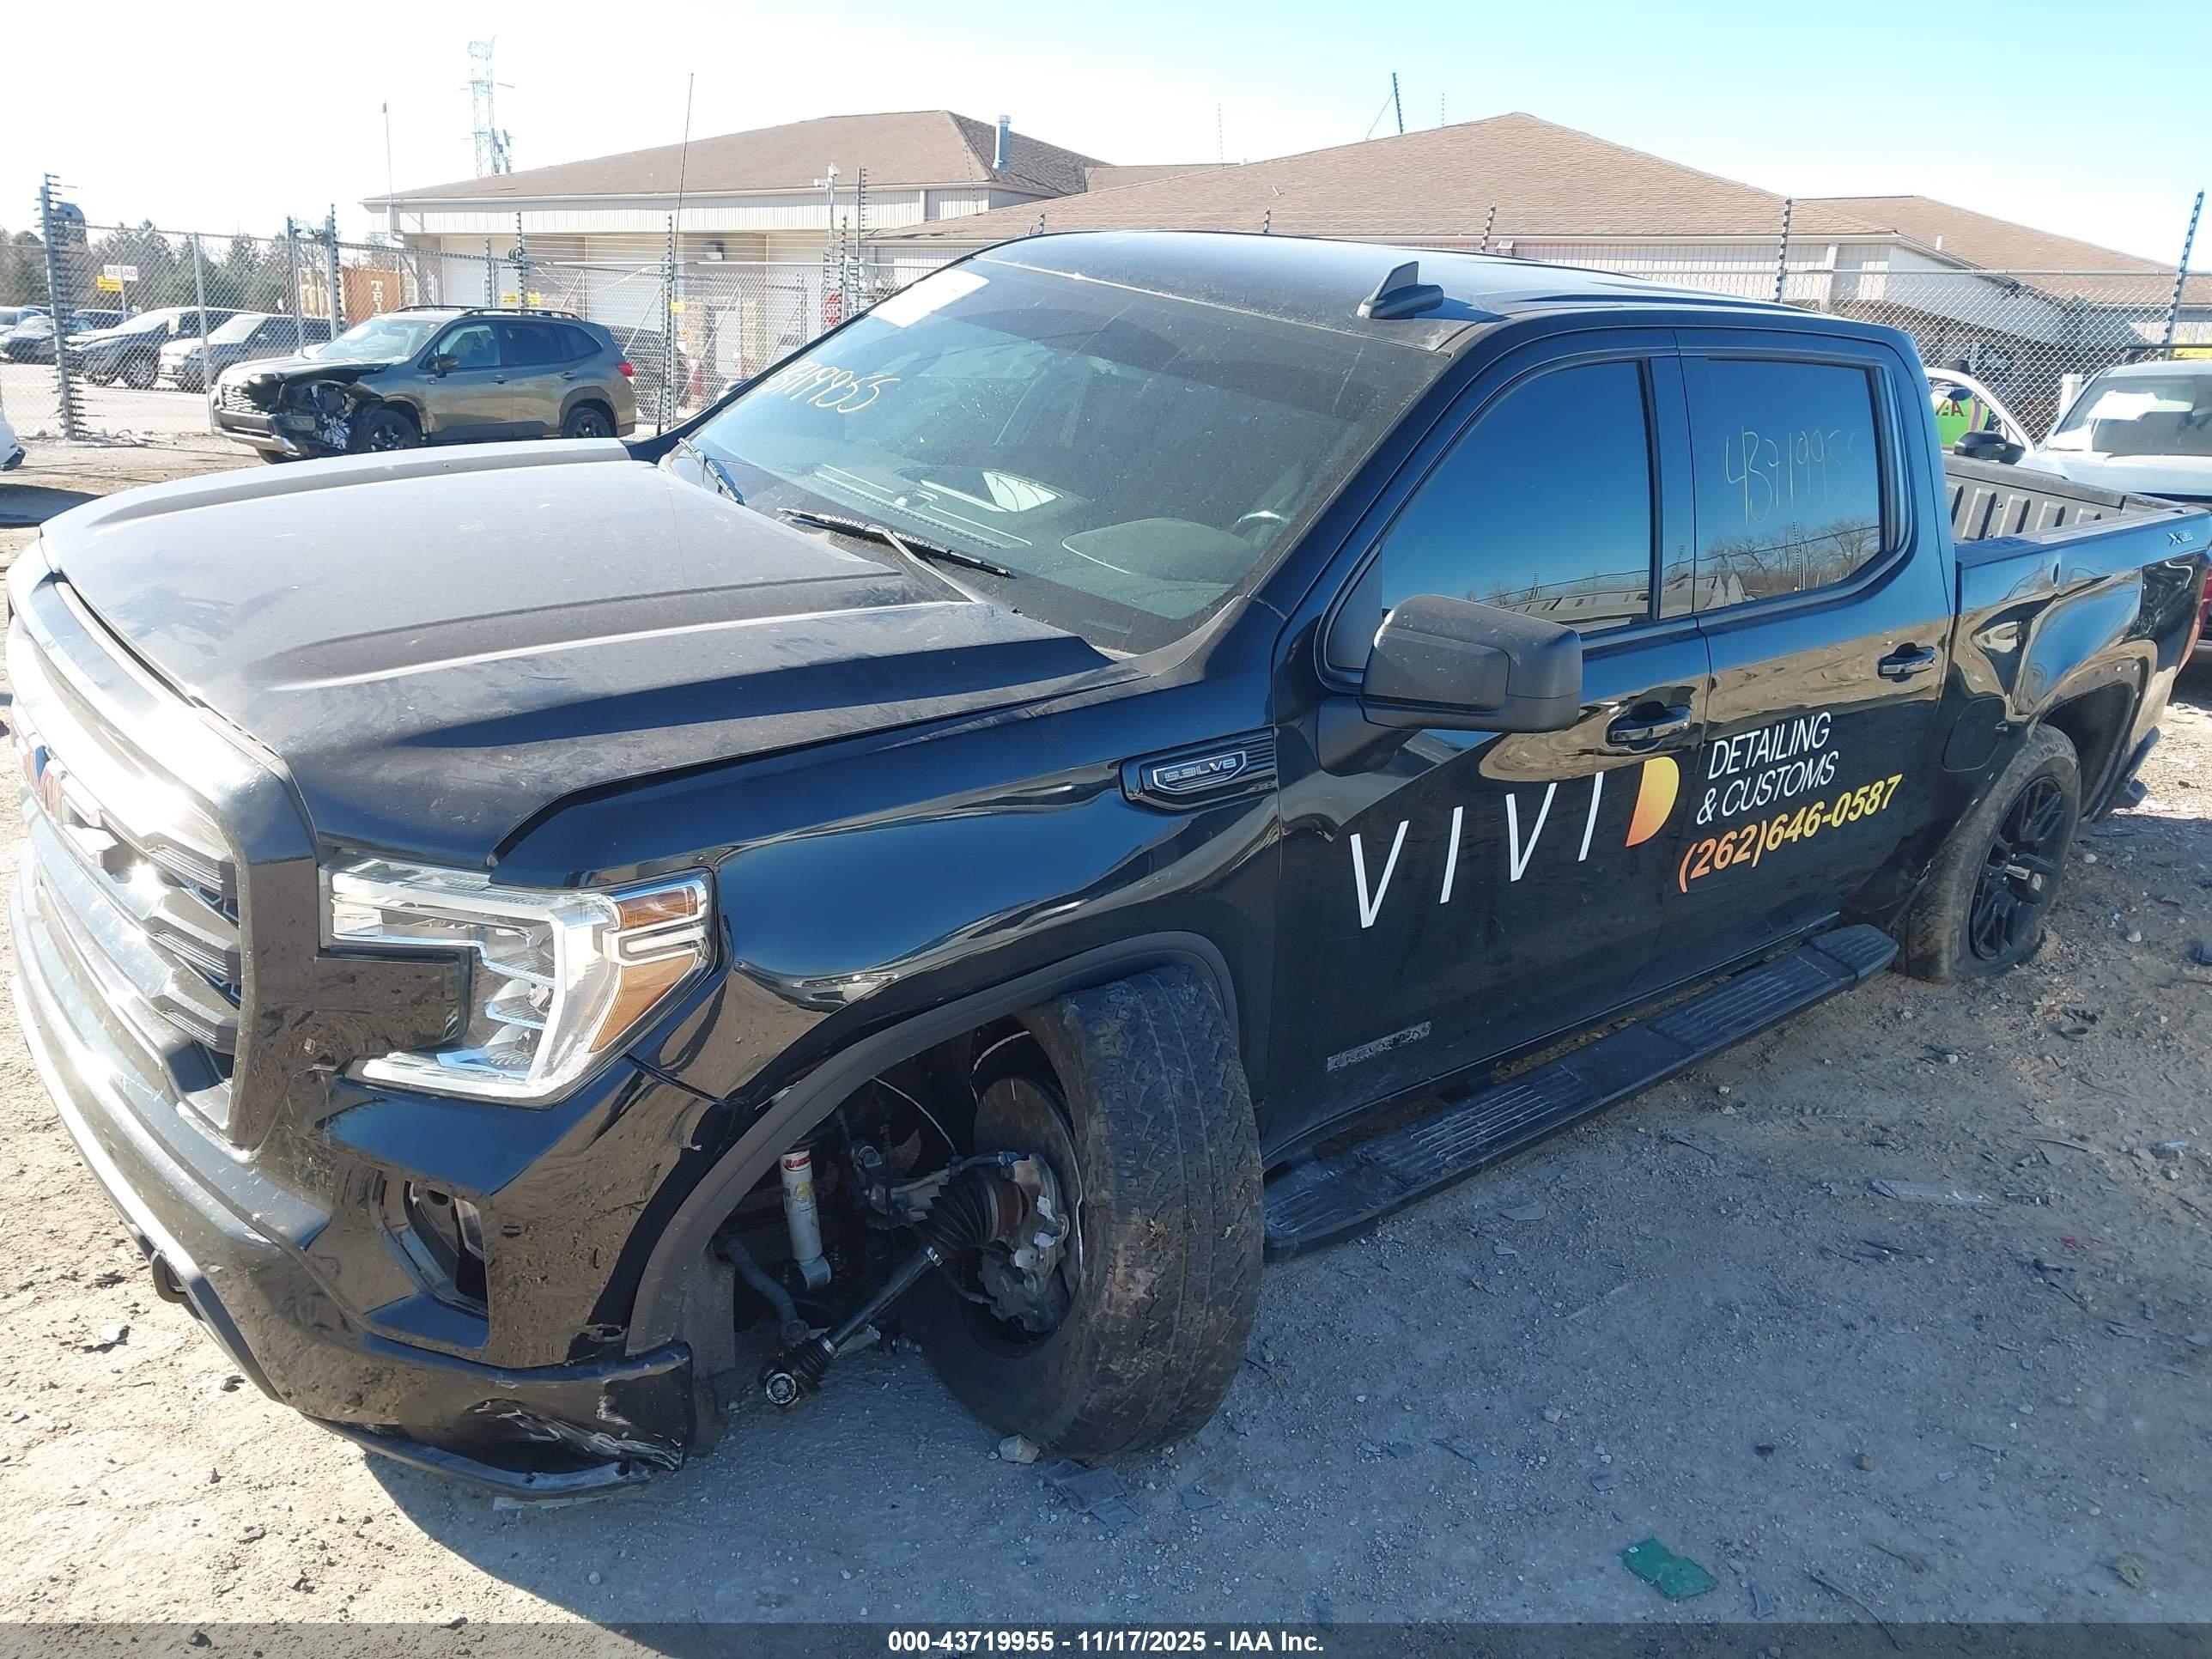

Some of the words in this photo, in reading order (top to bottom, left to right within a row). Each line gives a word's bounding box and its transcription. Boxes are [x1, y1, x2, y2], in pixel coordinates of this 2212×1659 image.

[1695, 787, 1718, 826] &
[1721, 750, 1840, 817] CUSTOMS
[1707, 711, 1832, 781] DETAILING
[1349, 756, 1680, 929] VIVID
[1678, 773, 1904, 894] (262)646-0587
